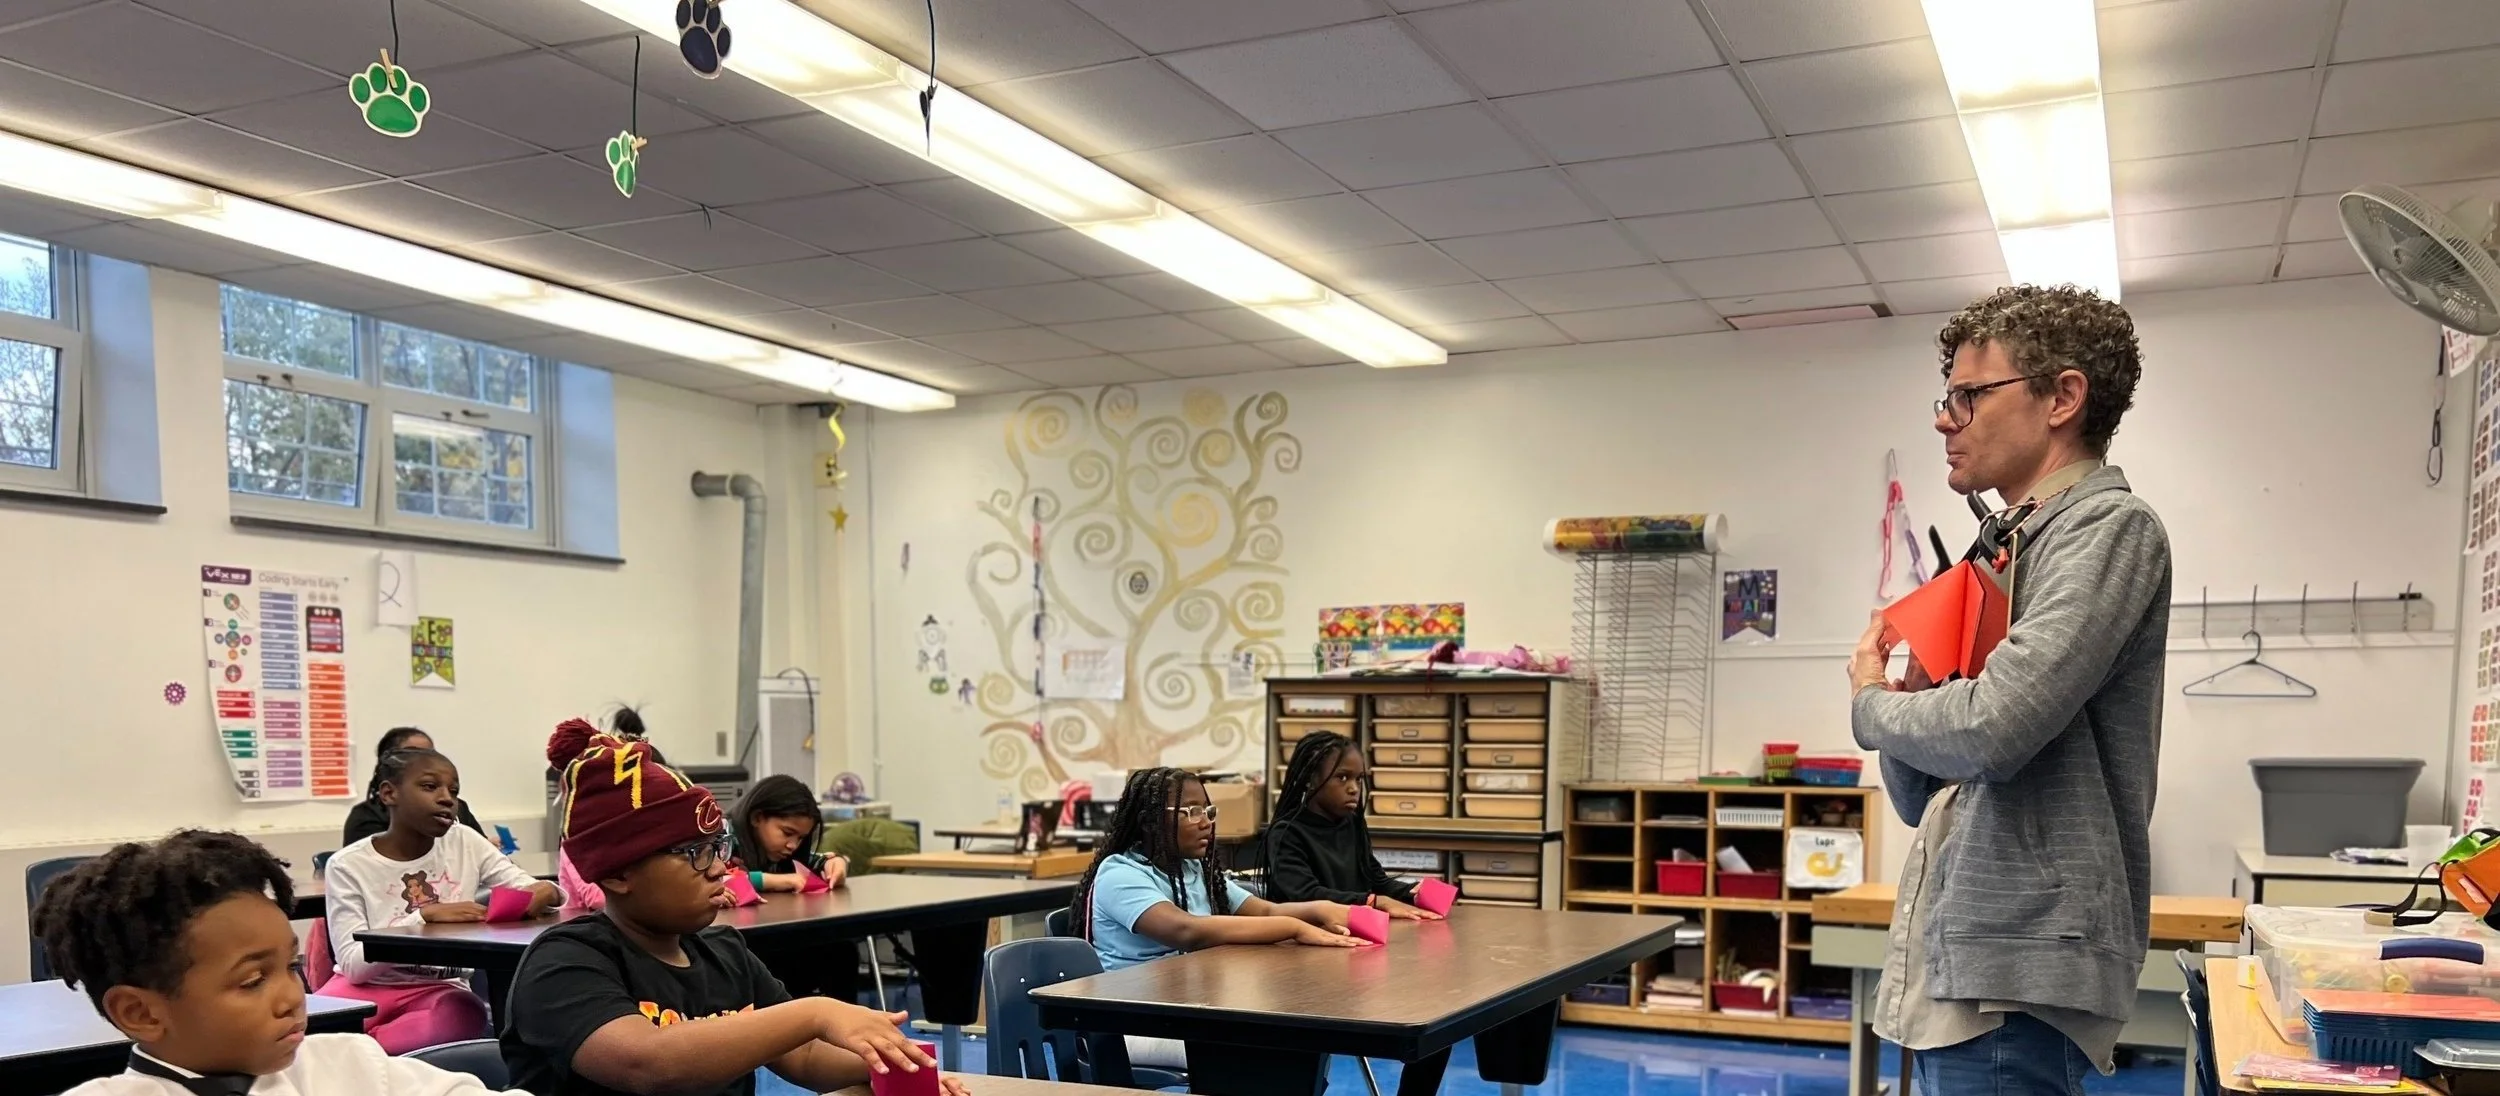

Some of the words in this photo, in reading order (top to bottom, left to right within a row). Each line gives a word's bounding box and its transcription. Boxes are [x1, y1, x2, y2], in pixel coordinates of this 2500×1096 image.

[258, 572, 291, 587] Coding
[292, 575, 317, 587] Starts
[319, 577, 339, 590] Early
[1738, 574, 1760, 598] M
[428, 620, 436, 645] E
